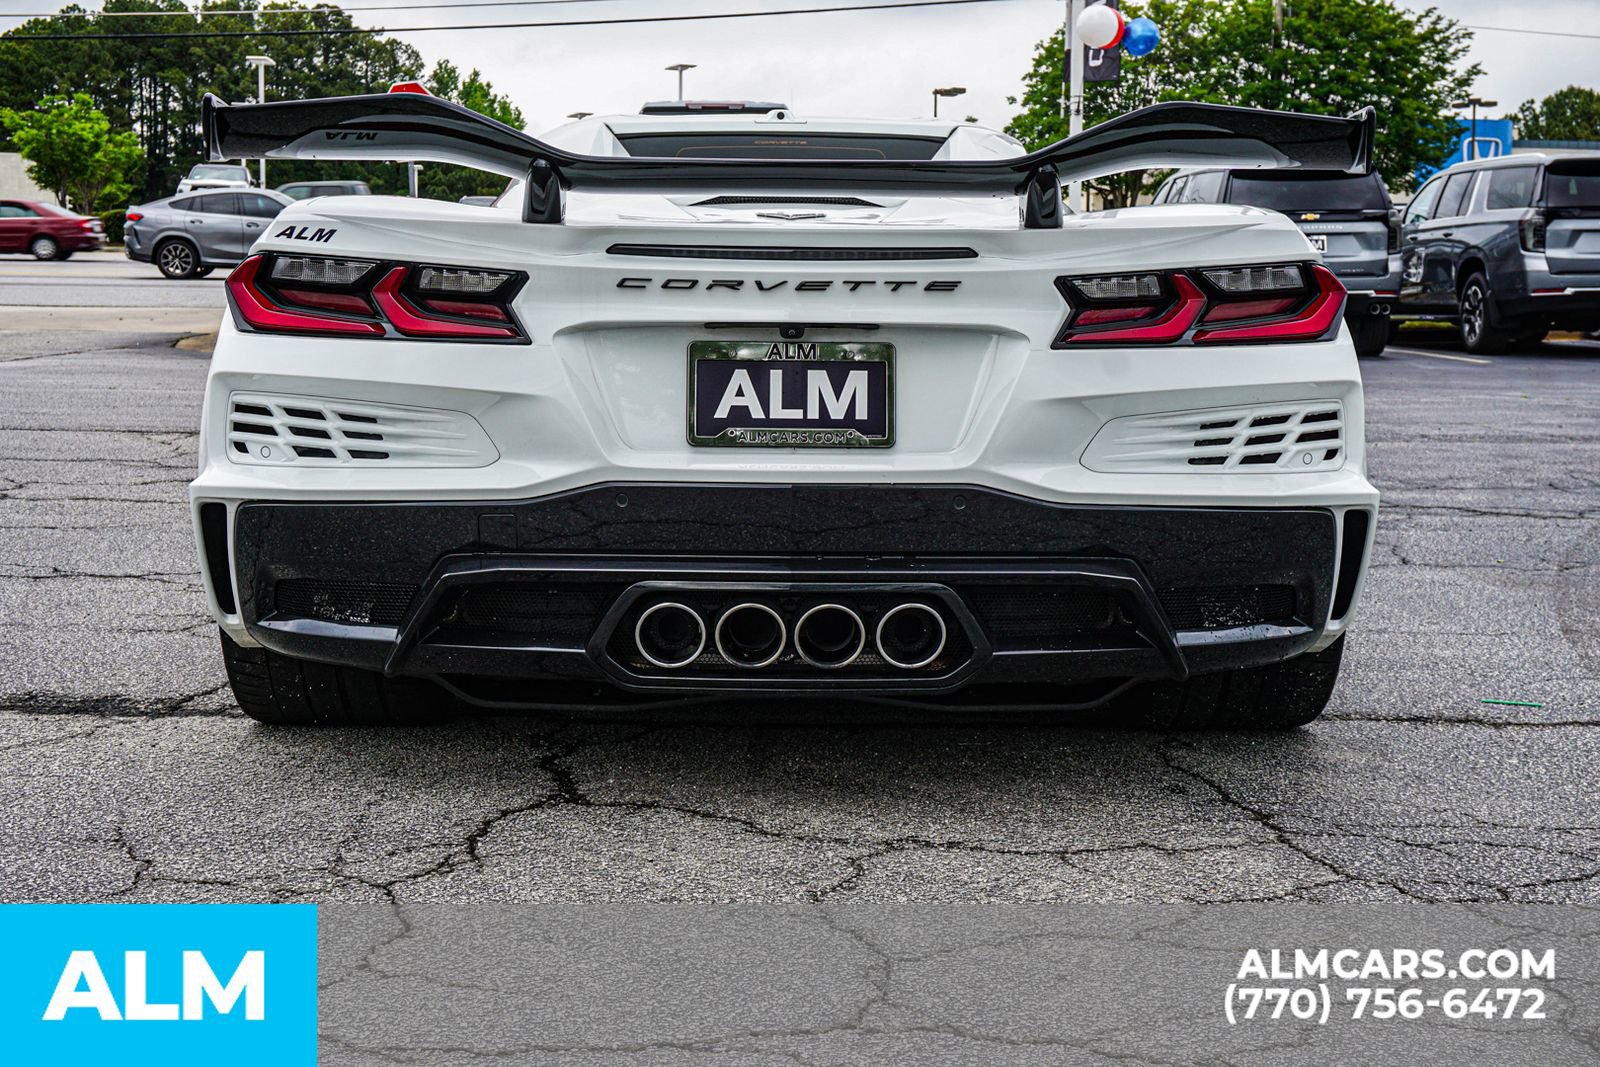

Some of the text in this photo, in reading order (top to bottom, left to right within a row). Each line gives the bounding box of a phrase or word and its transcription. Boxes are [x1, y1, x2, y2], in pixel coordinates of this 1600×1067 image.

[275, 225, 337, 242] ALM
[616, 277, 962, 292] CORVETTE
[766, 343, 818, 360] ALM
[713, 369, 868, 420] ALM
[736, 428, 847, 443] ALMCARS.COM
